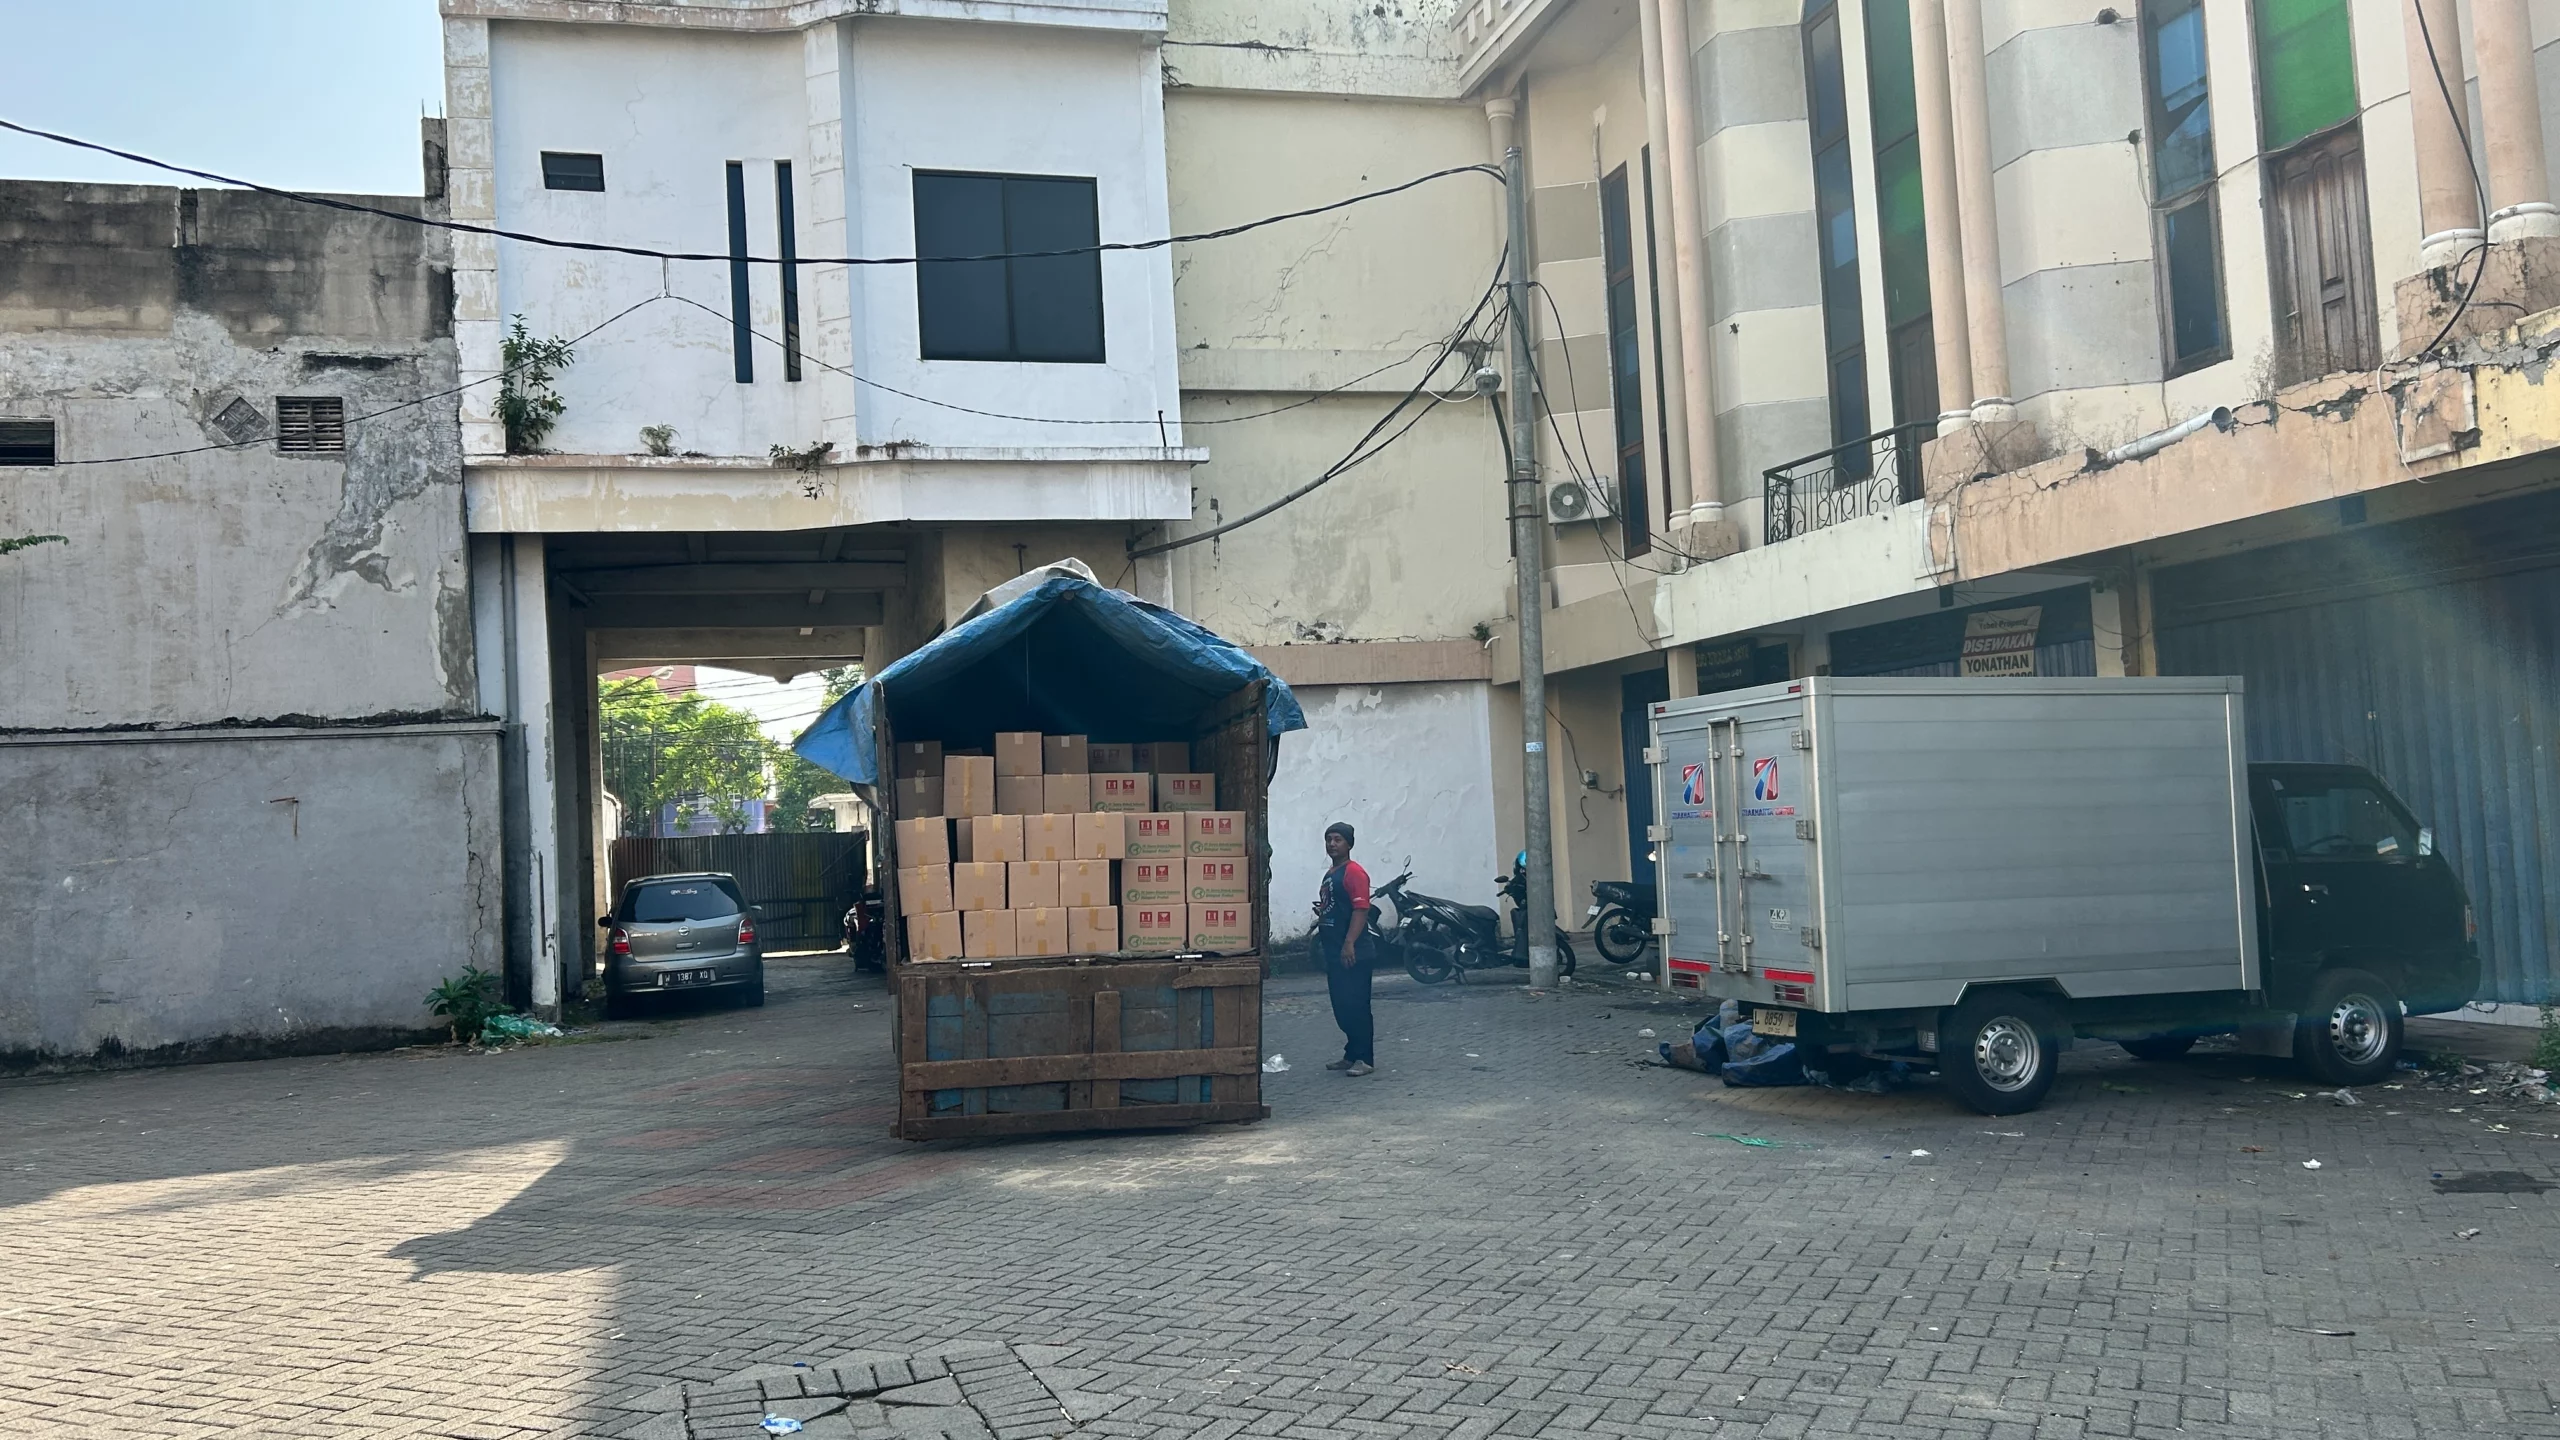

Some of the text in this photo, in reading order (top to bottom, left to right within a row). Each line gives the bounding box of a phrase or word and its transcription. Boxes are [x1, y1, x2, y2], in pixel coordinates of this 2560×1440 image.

[1963, 632, 2035, 653] DISEWAKAN
[1966, 654, 2029, 673] YONATHAN
[677, 972, 693, 981] 1387
[1754, 1010, 1760, 1025] L
[1764, 1011, 1784, 1027] 8859
